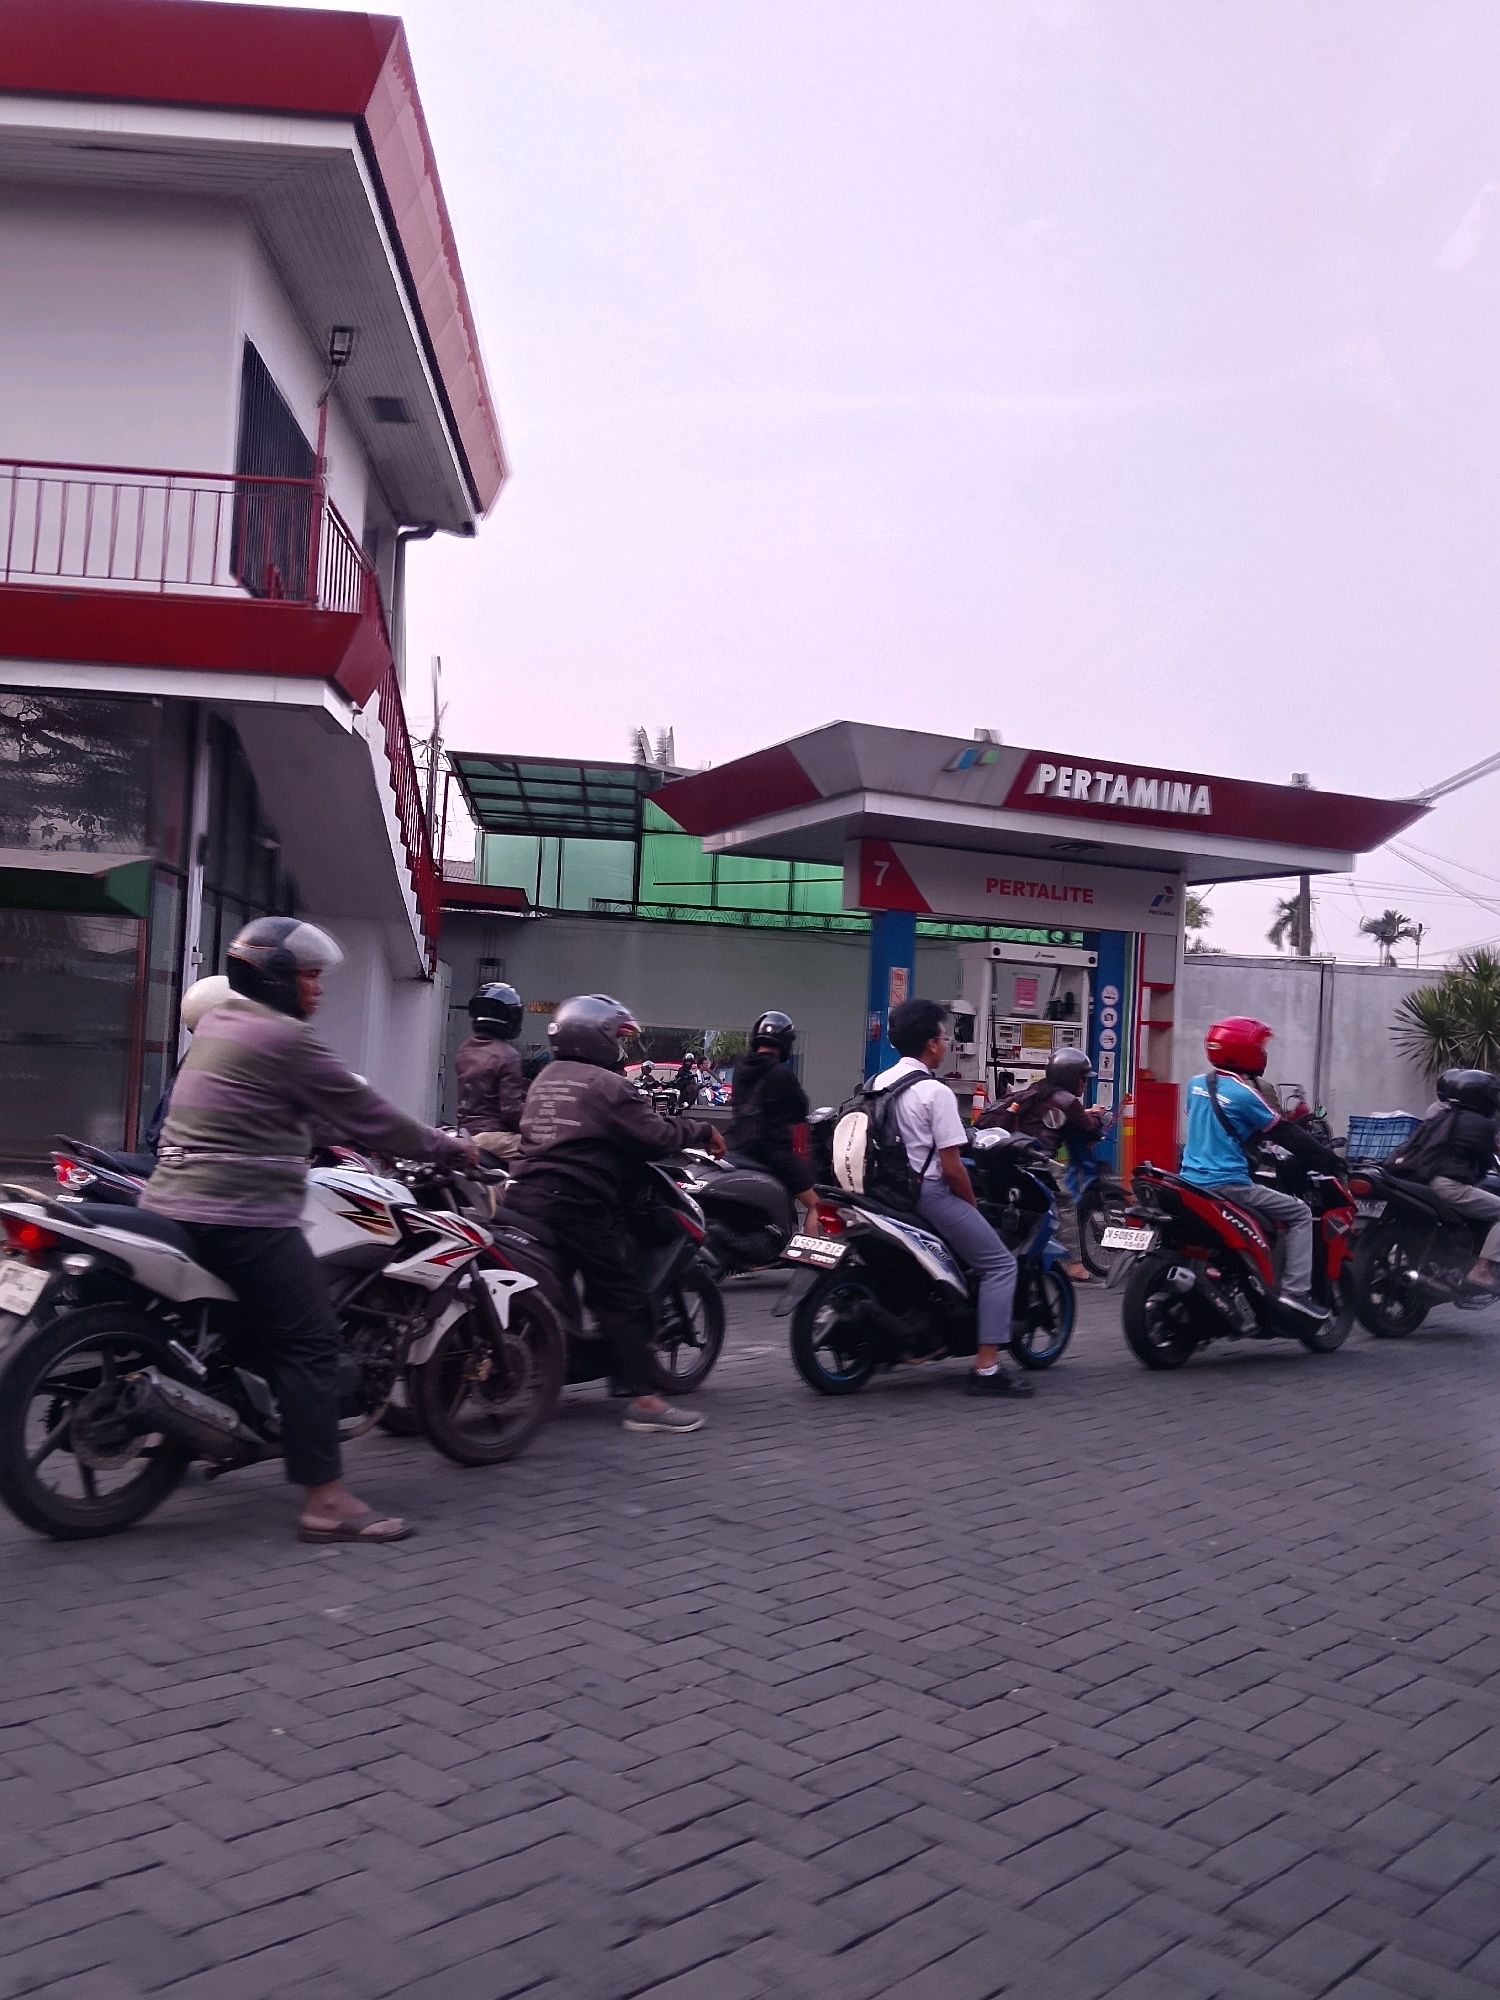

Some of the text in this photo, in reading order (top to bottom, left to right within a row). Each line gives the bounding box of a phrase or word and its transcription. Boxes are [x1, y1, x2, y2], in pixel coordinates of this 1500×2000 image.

[1027, 763, 1212, 815] PERTAMINA
[874, 860, 890, 886] 7
[986, 878, 1094, 904] PERTALITE
